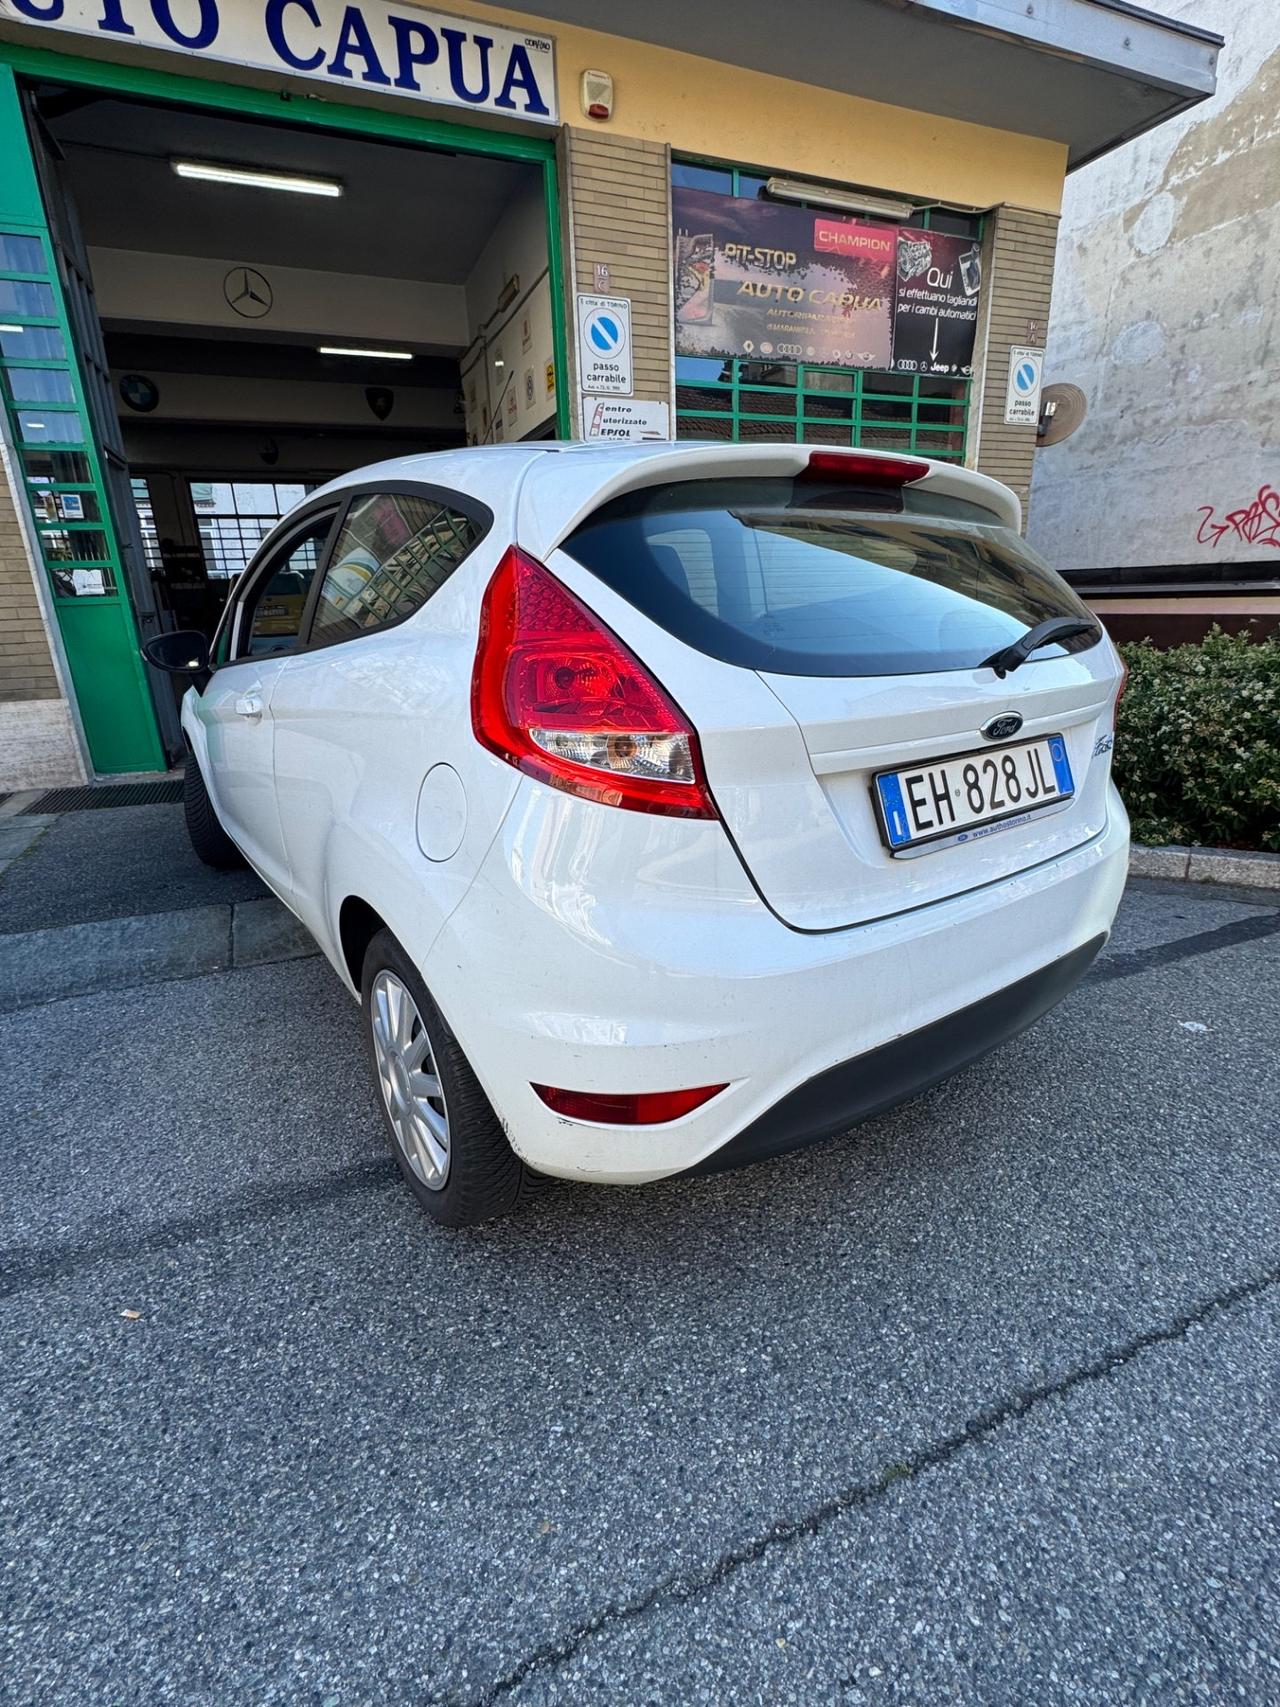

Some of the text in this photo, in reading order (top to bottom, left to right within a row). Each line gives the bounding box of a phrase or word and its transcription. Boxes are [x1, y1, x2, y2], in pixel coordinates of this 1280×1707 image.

[265, 0, 550, 115] CAPUA
[818, 231, 891, 252] CHAMPION
[927, 267, 954, 290] Qui
[736, 280, 882, 311] AUTO CAPUA
[898, 287, 977, 307] si effettuano tagliandi
[897, 303, 912, 313] per
[915, 305, 938, 315] cambi
[938, 308, 977, 321] automatici
[593, 363, 619, 372] passo
[930, 362, 950, 374] Jeep
[586, 374, 627, 384] carrabile
[602, 417, 648, 425] utorizzato
[1009, 408, 1035, 416] carrabile
[992, 718, 1019, 736] Ford
